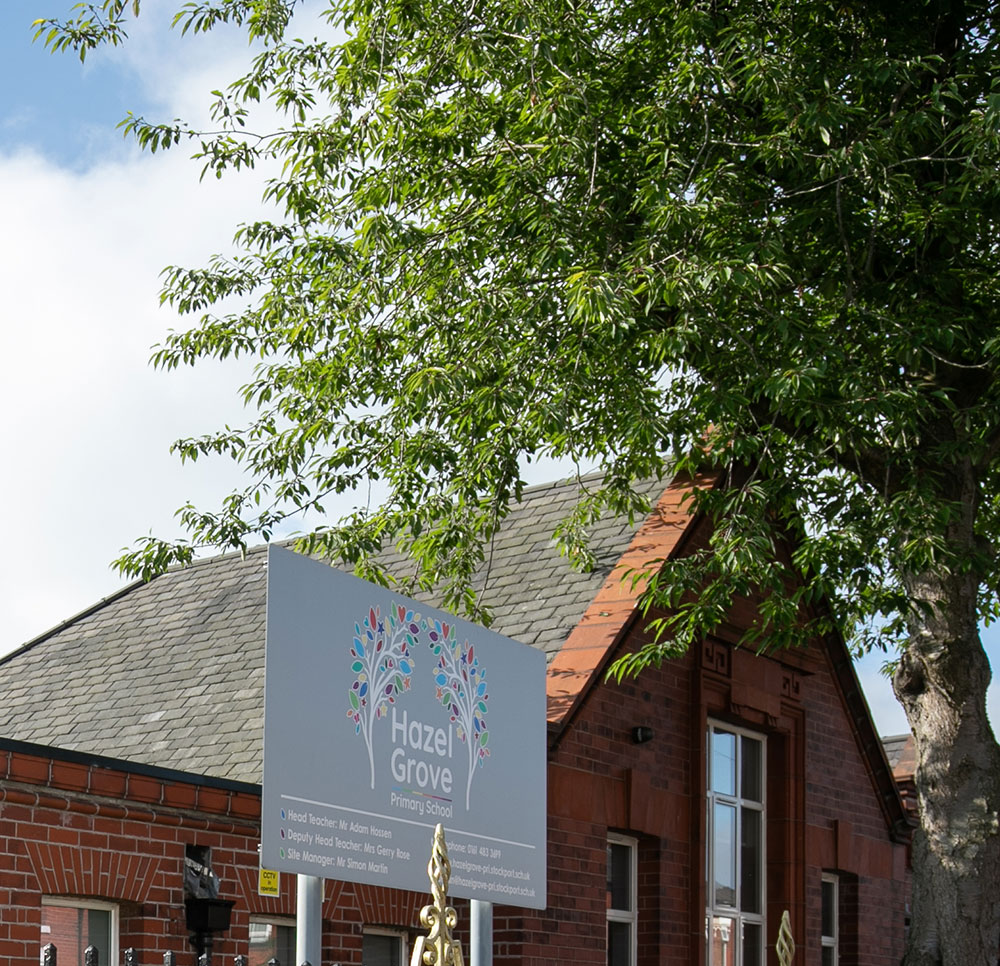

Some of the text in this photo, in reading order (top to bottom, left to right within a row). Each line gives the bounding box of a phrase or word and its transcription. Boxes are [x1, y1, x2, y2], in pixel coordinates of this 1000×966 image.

[391, 706, 452, 758] Hazel
[391, 747, 453, 794] Grove
[391, 792, 453, 818] Primary School
[288, 809, 392, 839] Head Teacher: Mr Adam Hossen
[288, 829, 411, 860] Deputy Head Teacher: Mrs Gerry Rose
[263, 871, 276, 880] CCTV
[287, 848, 388, 874] Site Manager: Mr Simon Martin
